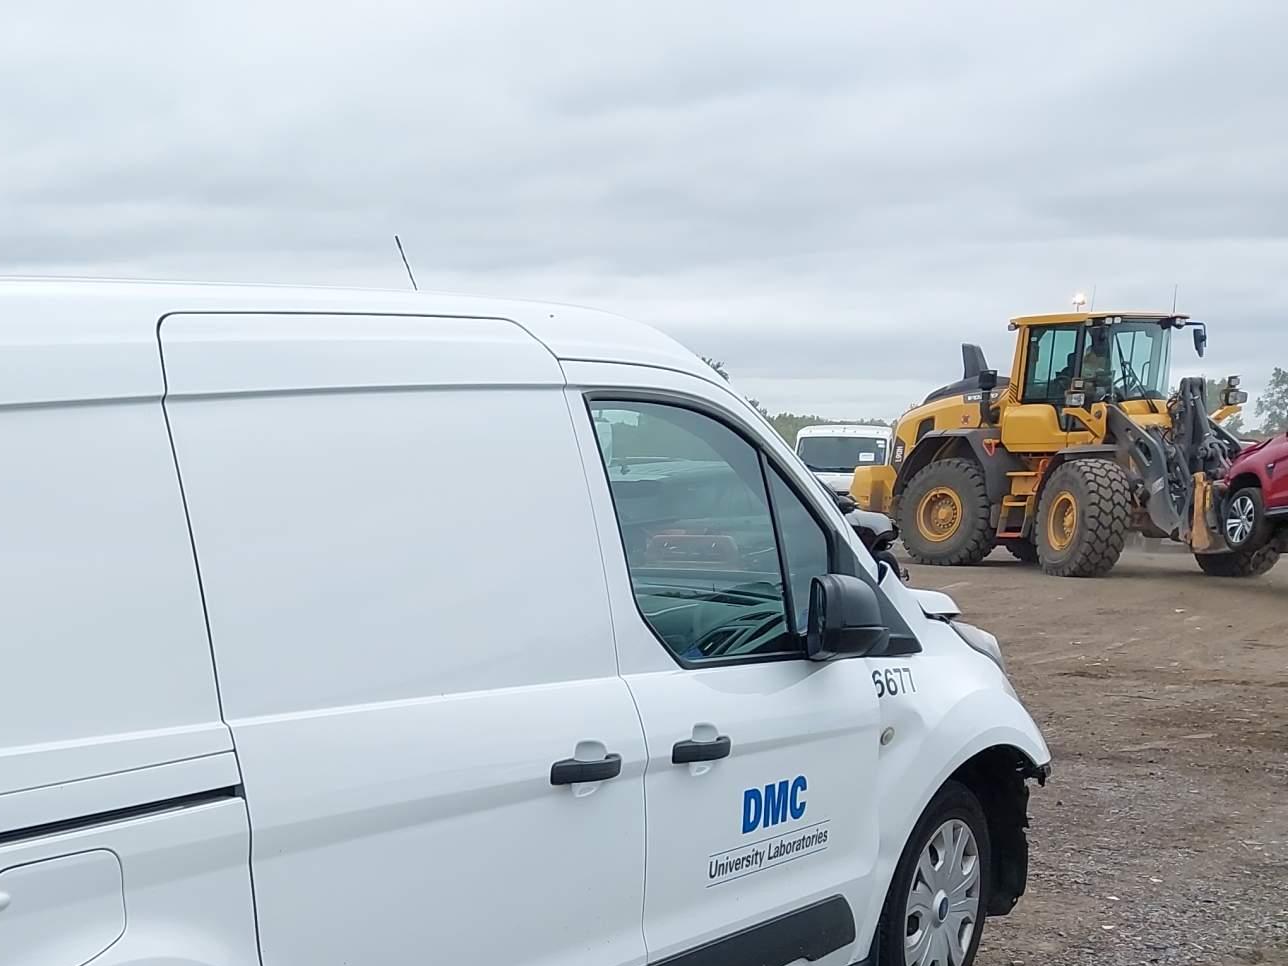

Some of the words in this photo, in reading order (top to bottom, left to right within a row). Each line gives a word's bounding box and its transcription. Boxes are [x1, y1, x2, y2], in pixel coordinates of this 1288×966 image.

[741, 775, 808, 835] DMC
[708, 848, 766, 879] University
[767, 828, 829, 861] Laboratories
